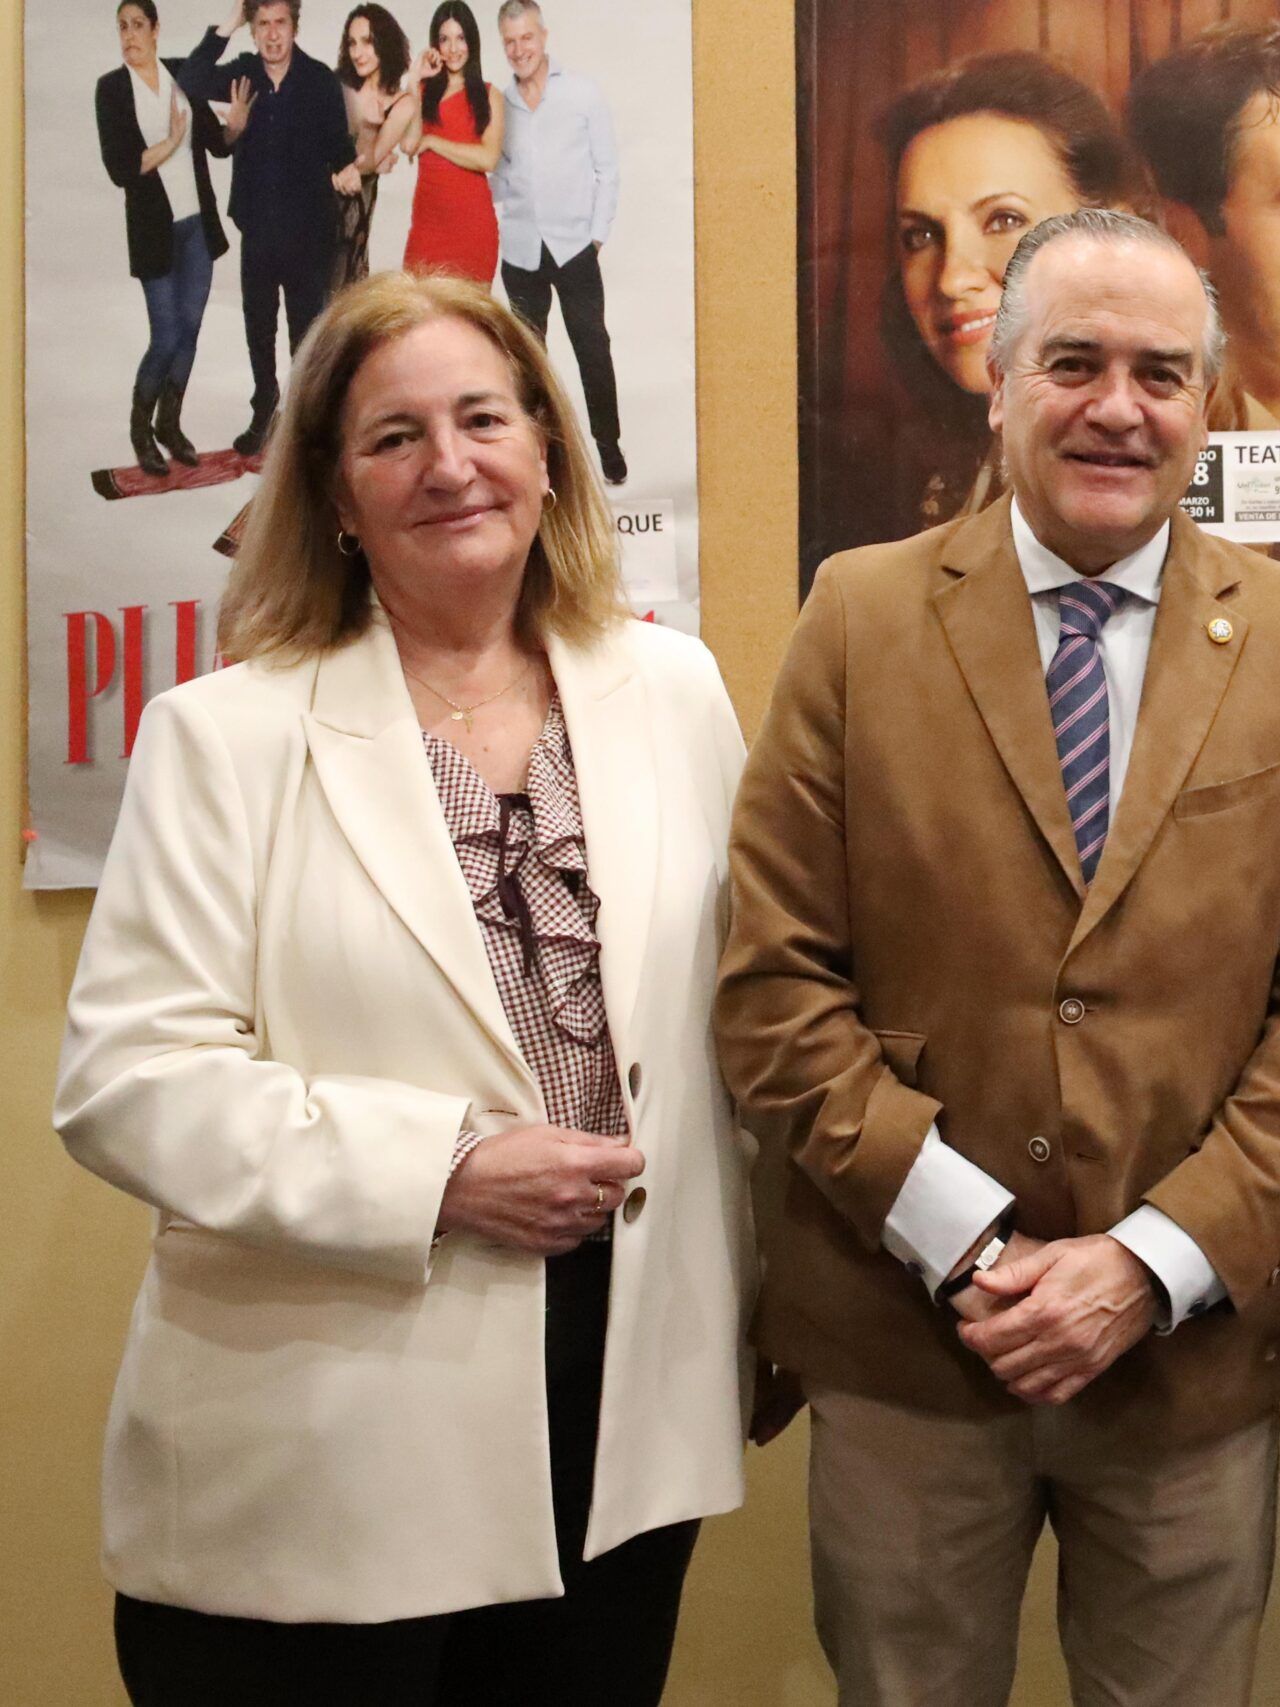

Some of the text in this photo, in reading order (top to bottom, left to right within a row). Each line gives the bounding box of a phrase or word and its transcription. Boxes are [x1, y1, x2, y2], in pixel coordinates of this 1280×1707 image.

[1189, 461, 1210, 486] 8
[1206, 506, 1216, 517] H
[1238, 512, 1264, 521] VENTA
[1265, 512, 1277, 520] DE
[616, 513, 664, 536] QUE
